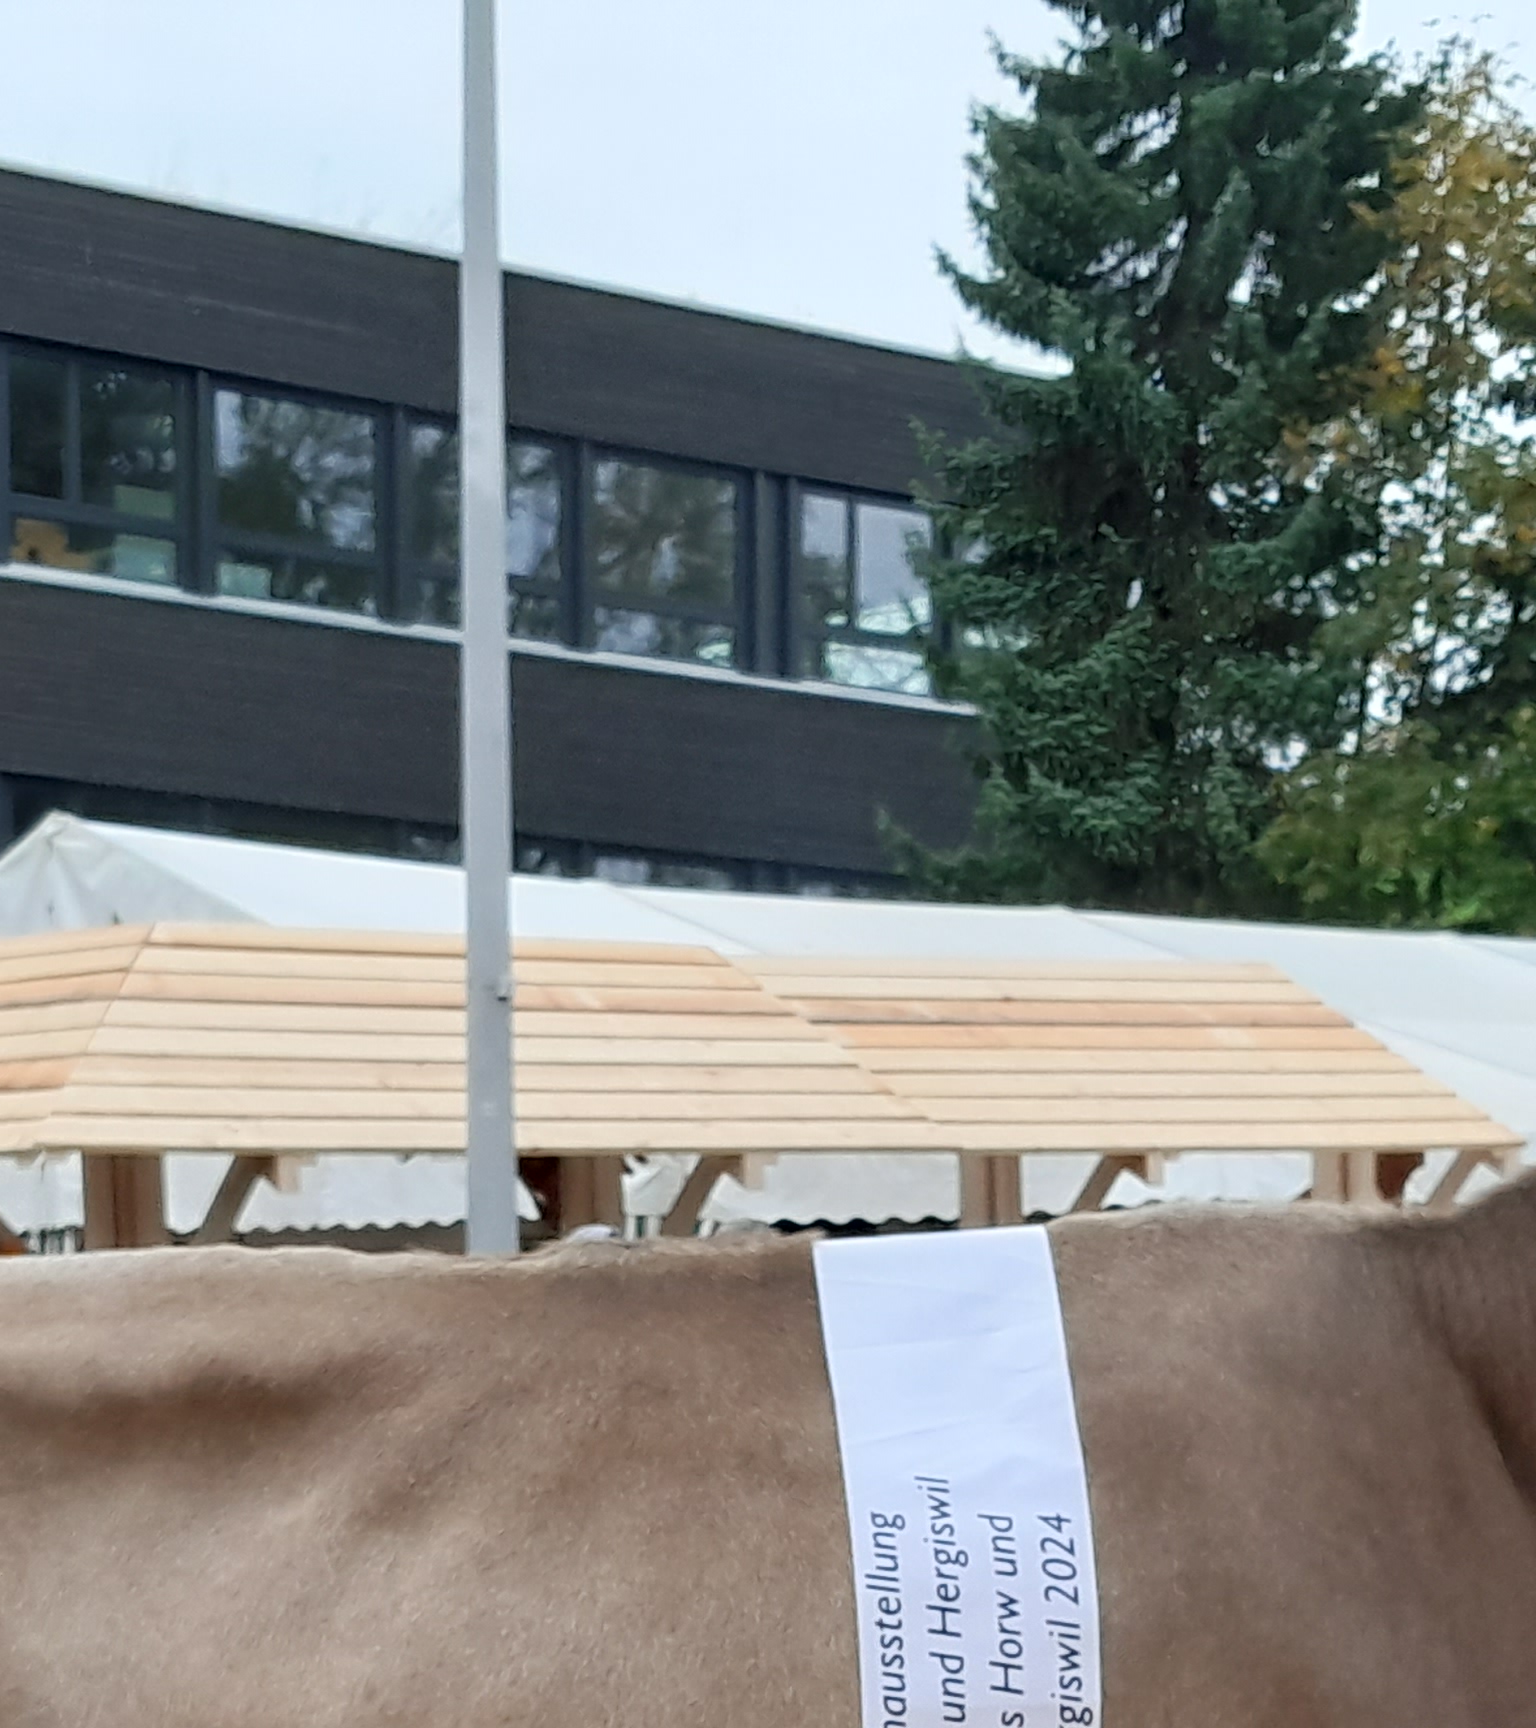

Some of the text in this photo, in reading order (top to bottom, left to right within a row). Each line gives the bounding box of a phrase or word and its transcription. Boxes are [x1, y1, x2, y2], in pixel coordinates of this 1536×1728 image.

[914, 1475, 969, 1639] Hergiswil
[977, 1513, 1019, 1578] und
[1037, 1512, 1081, 1606] 2024
[929, 1651, 966, 1723] und
[989, 1590, 1024, 1696] Horw
